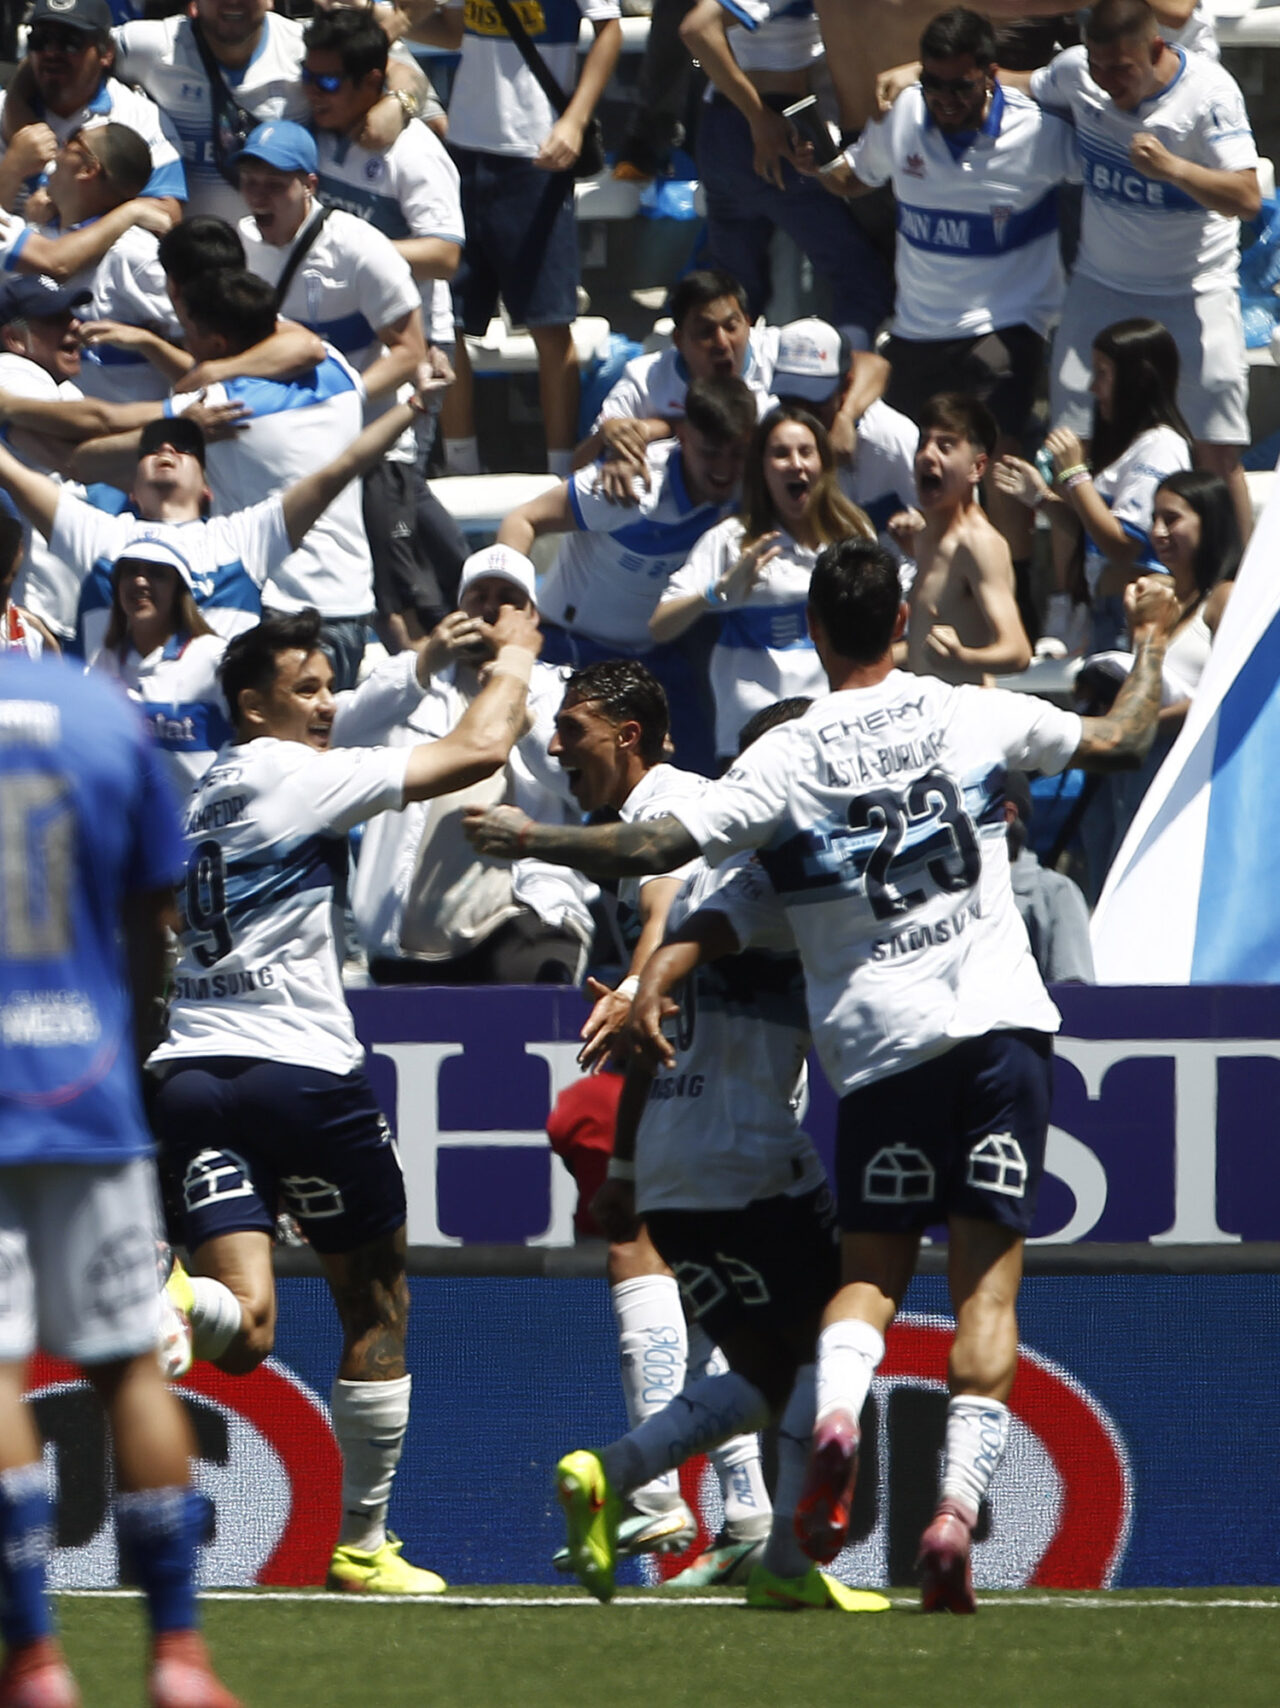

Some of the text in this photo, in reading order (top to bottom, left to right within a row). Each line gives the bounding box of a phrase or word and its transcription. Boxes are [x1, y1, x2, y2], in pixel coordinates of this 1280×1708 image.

[1093, 164, 1164, 204] BICE
[933, 217, 971, 249] AM
[818, 695, 925, 745] CHERY
[847, 769, 982, 922] 23
[186, 839, 233, 969] 9
[872, 902, 983, 962] SAMSUN
